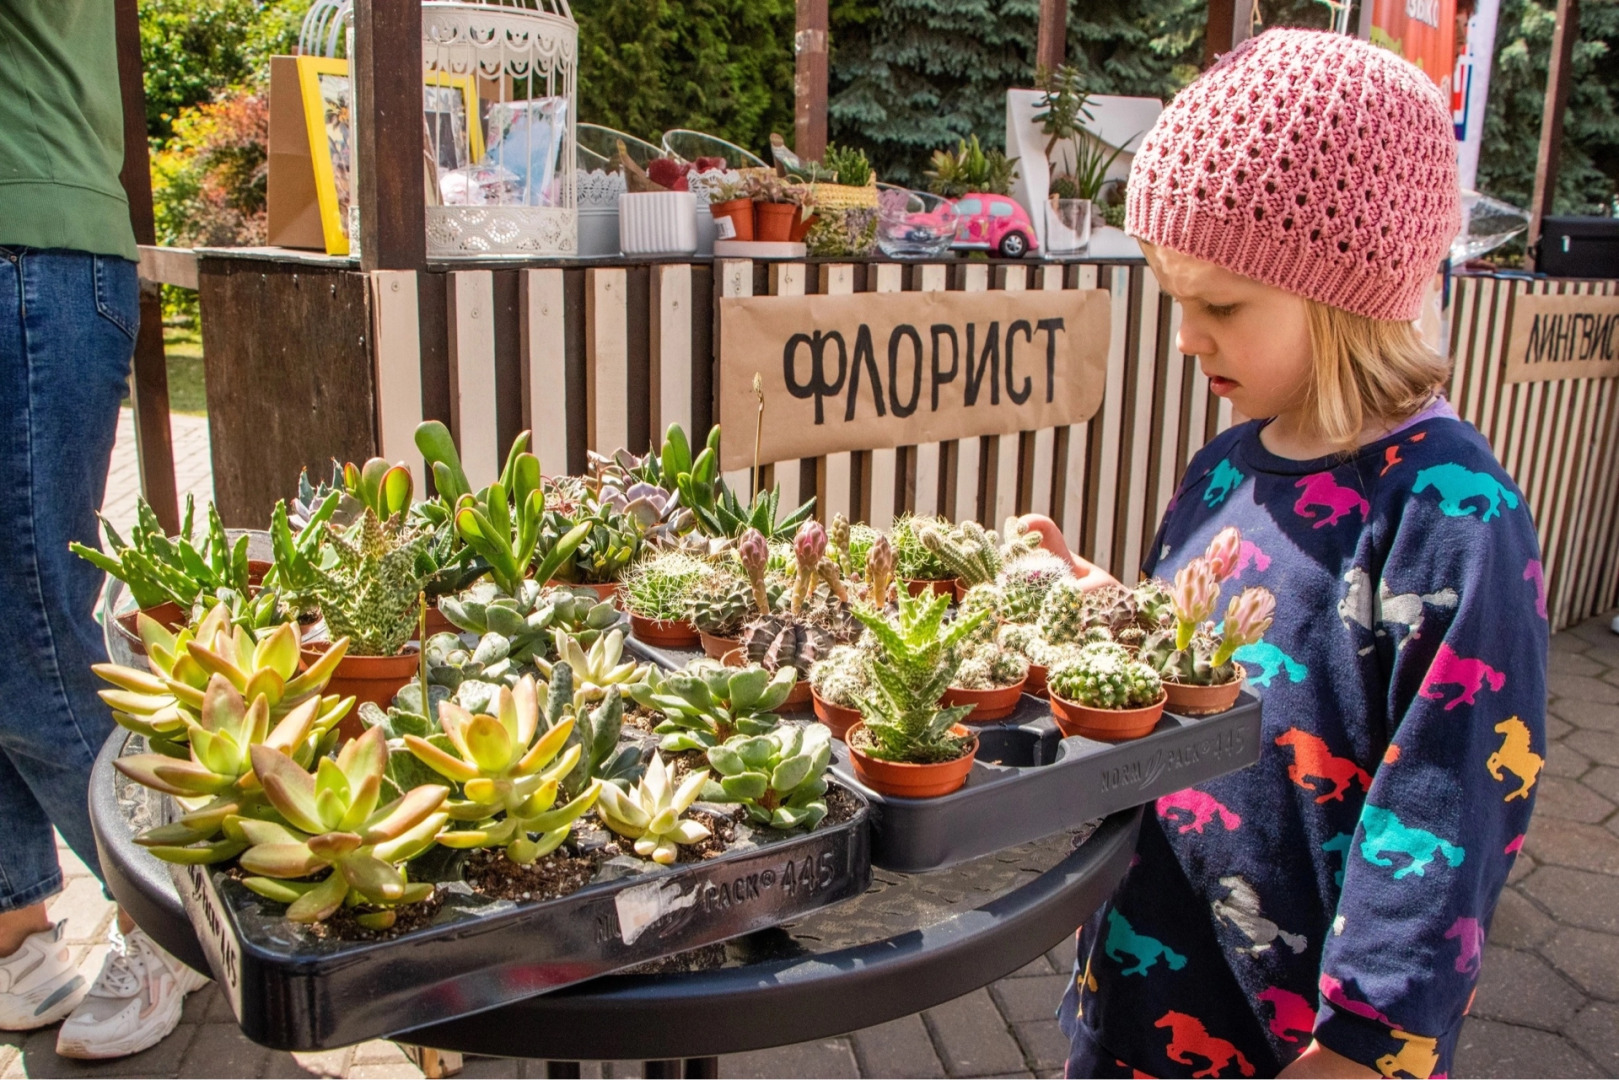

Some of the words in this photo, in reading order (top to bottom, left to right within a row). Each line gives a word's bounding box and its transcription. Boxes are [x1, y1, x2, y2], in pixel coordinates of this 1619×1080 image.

[1524, 313, 1619, 364] ЛИНГВИС
[783, 317, 1065, 425] ФЛОРИСТ
[1100, 760, 1142, 793] NORM
[1213, 727, 1246, 761] 445
[780, 852, 835, 899] 445
